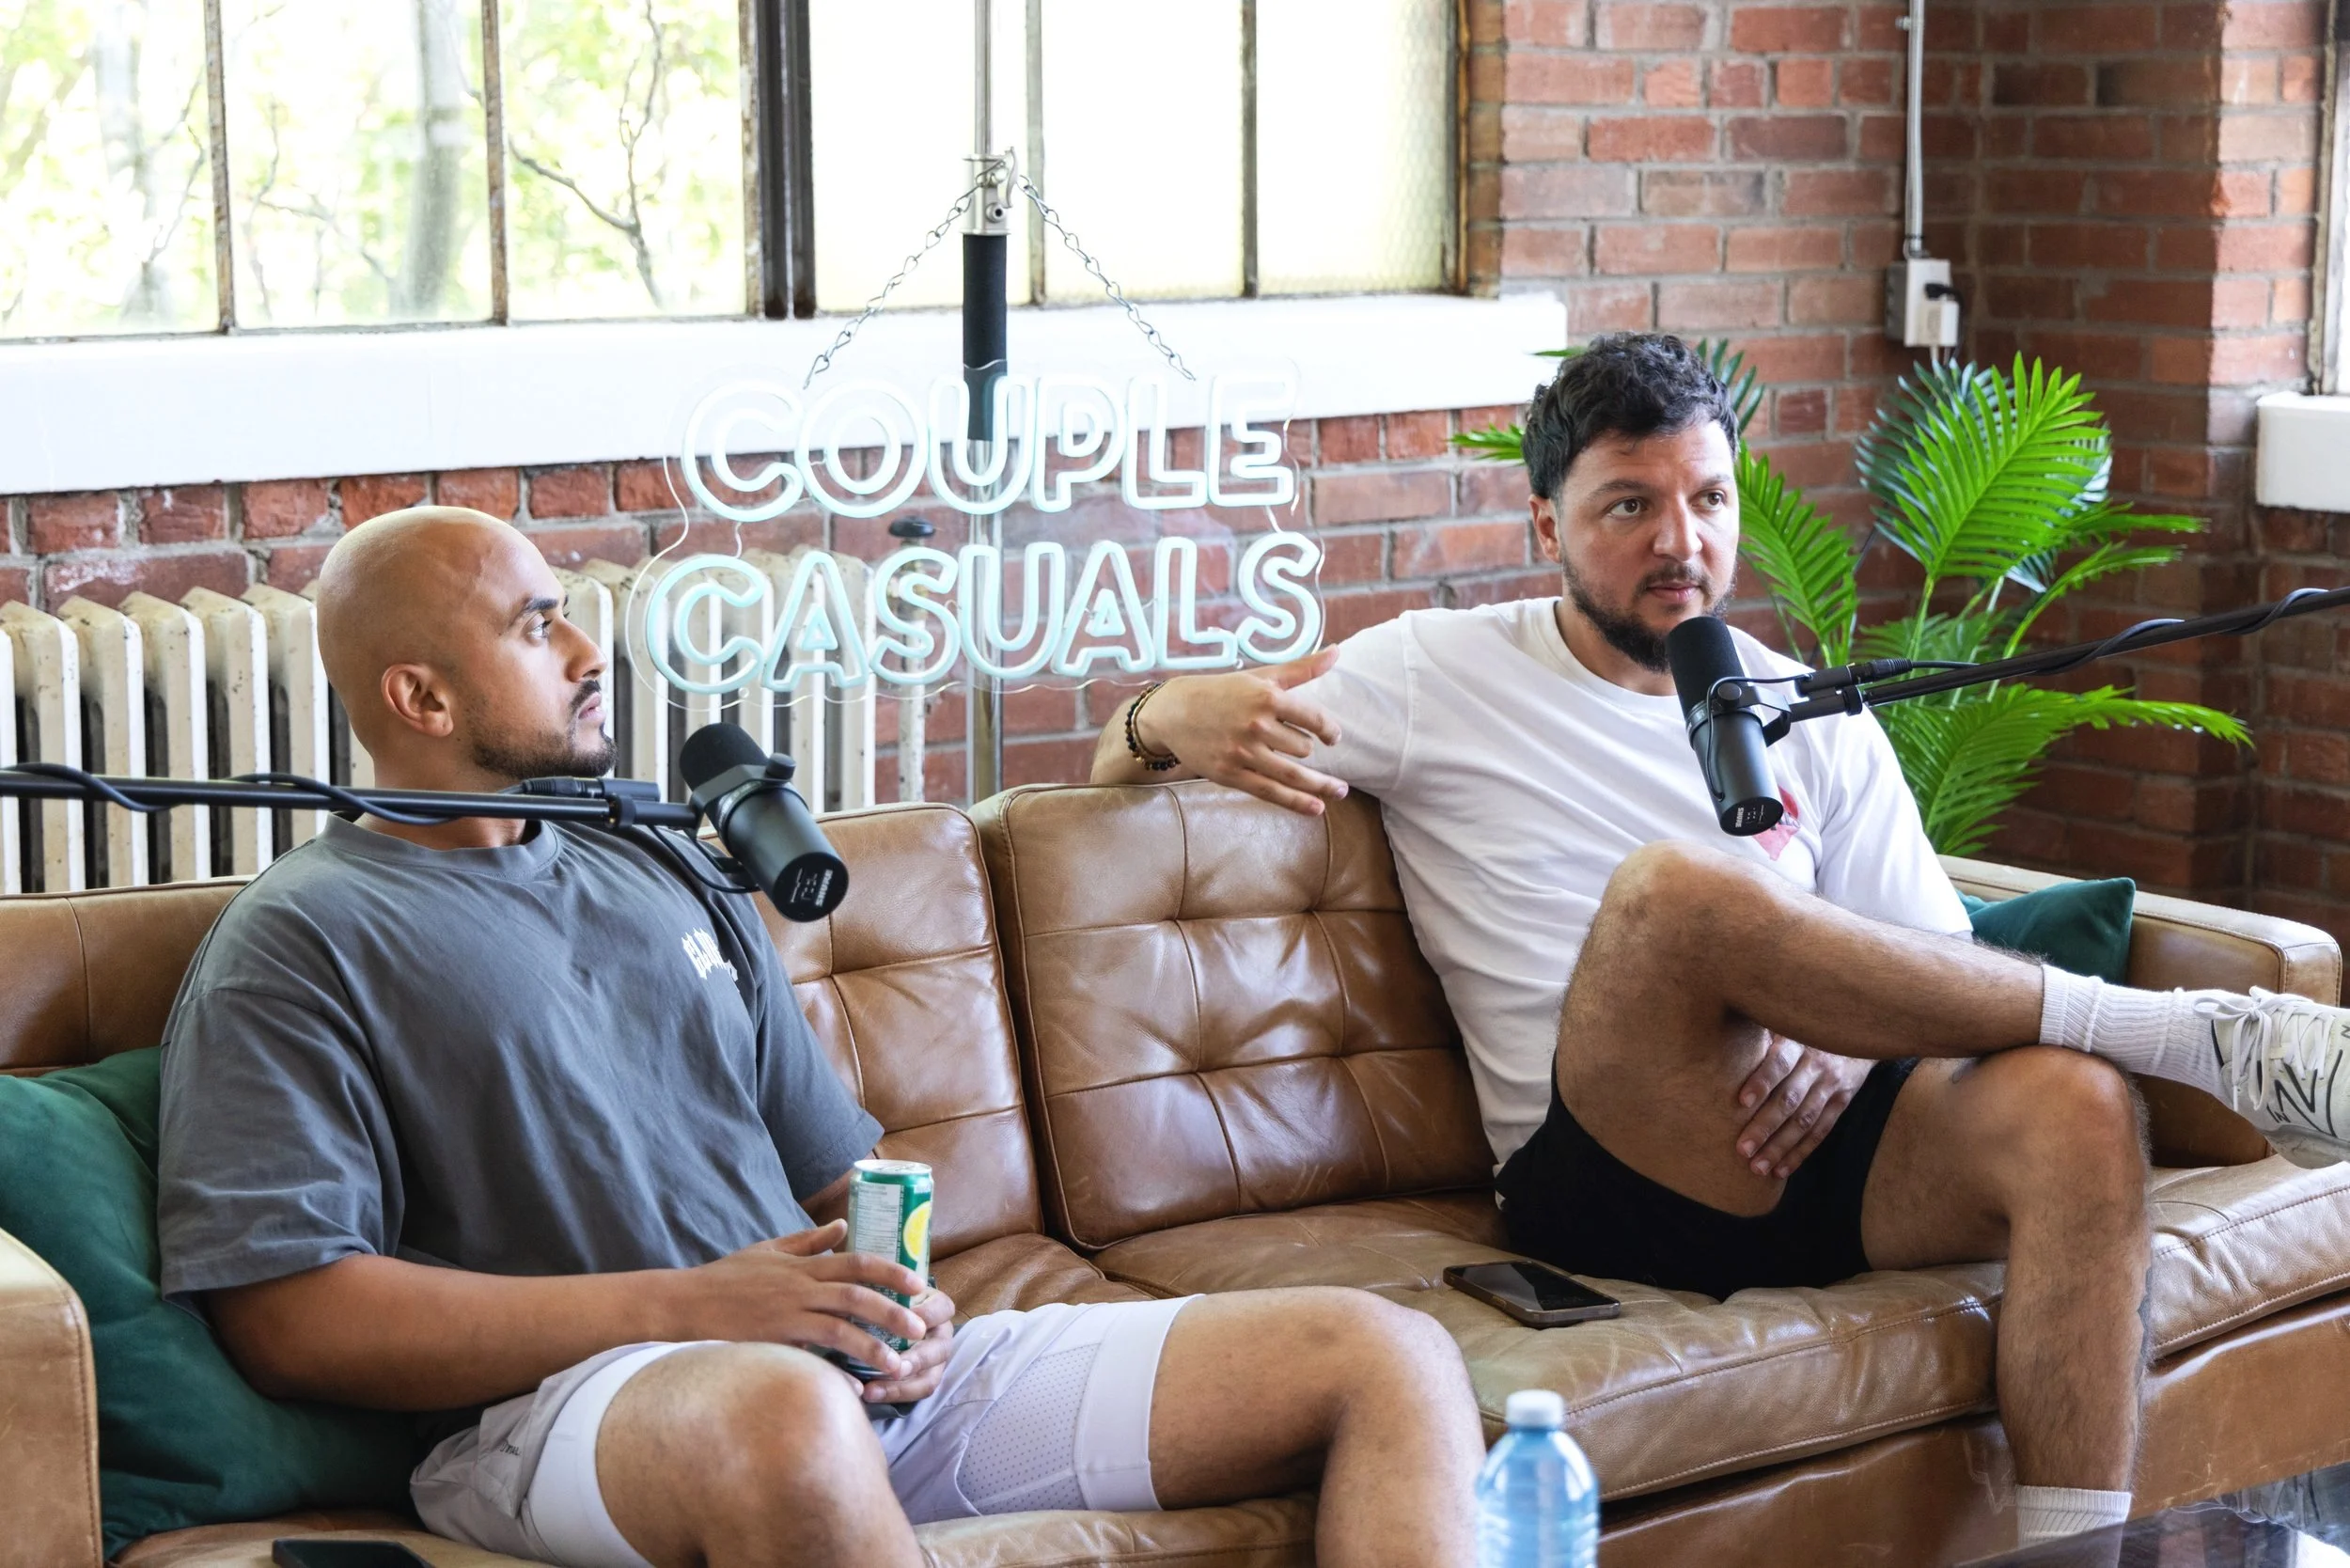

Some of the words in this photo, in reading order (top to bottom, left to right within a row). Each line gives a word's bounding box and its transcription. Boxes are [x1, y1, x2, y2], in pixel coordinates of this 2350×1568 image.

[682, 375, 1296, 523] COUPLE
[647, 531, 1322, 695] CASUALS
[815, 869, 834, 907] SHURE
